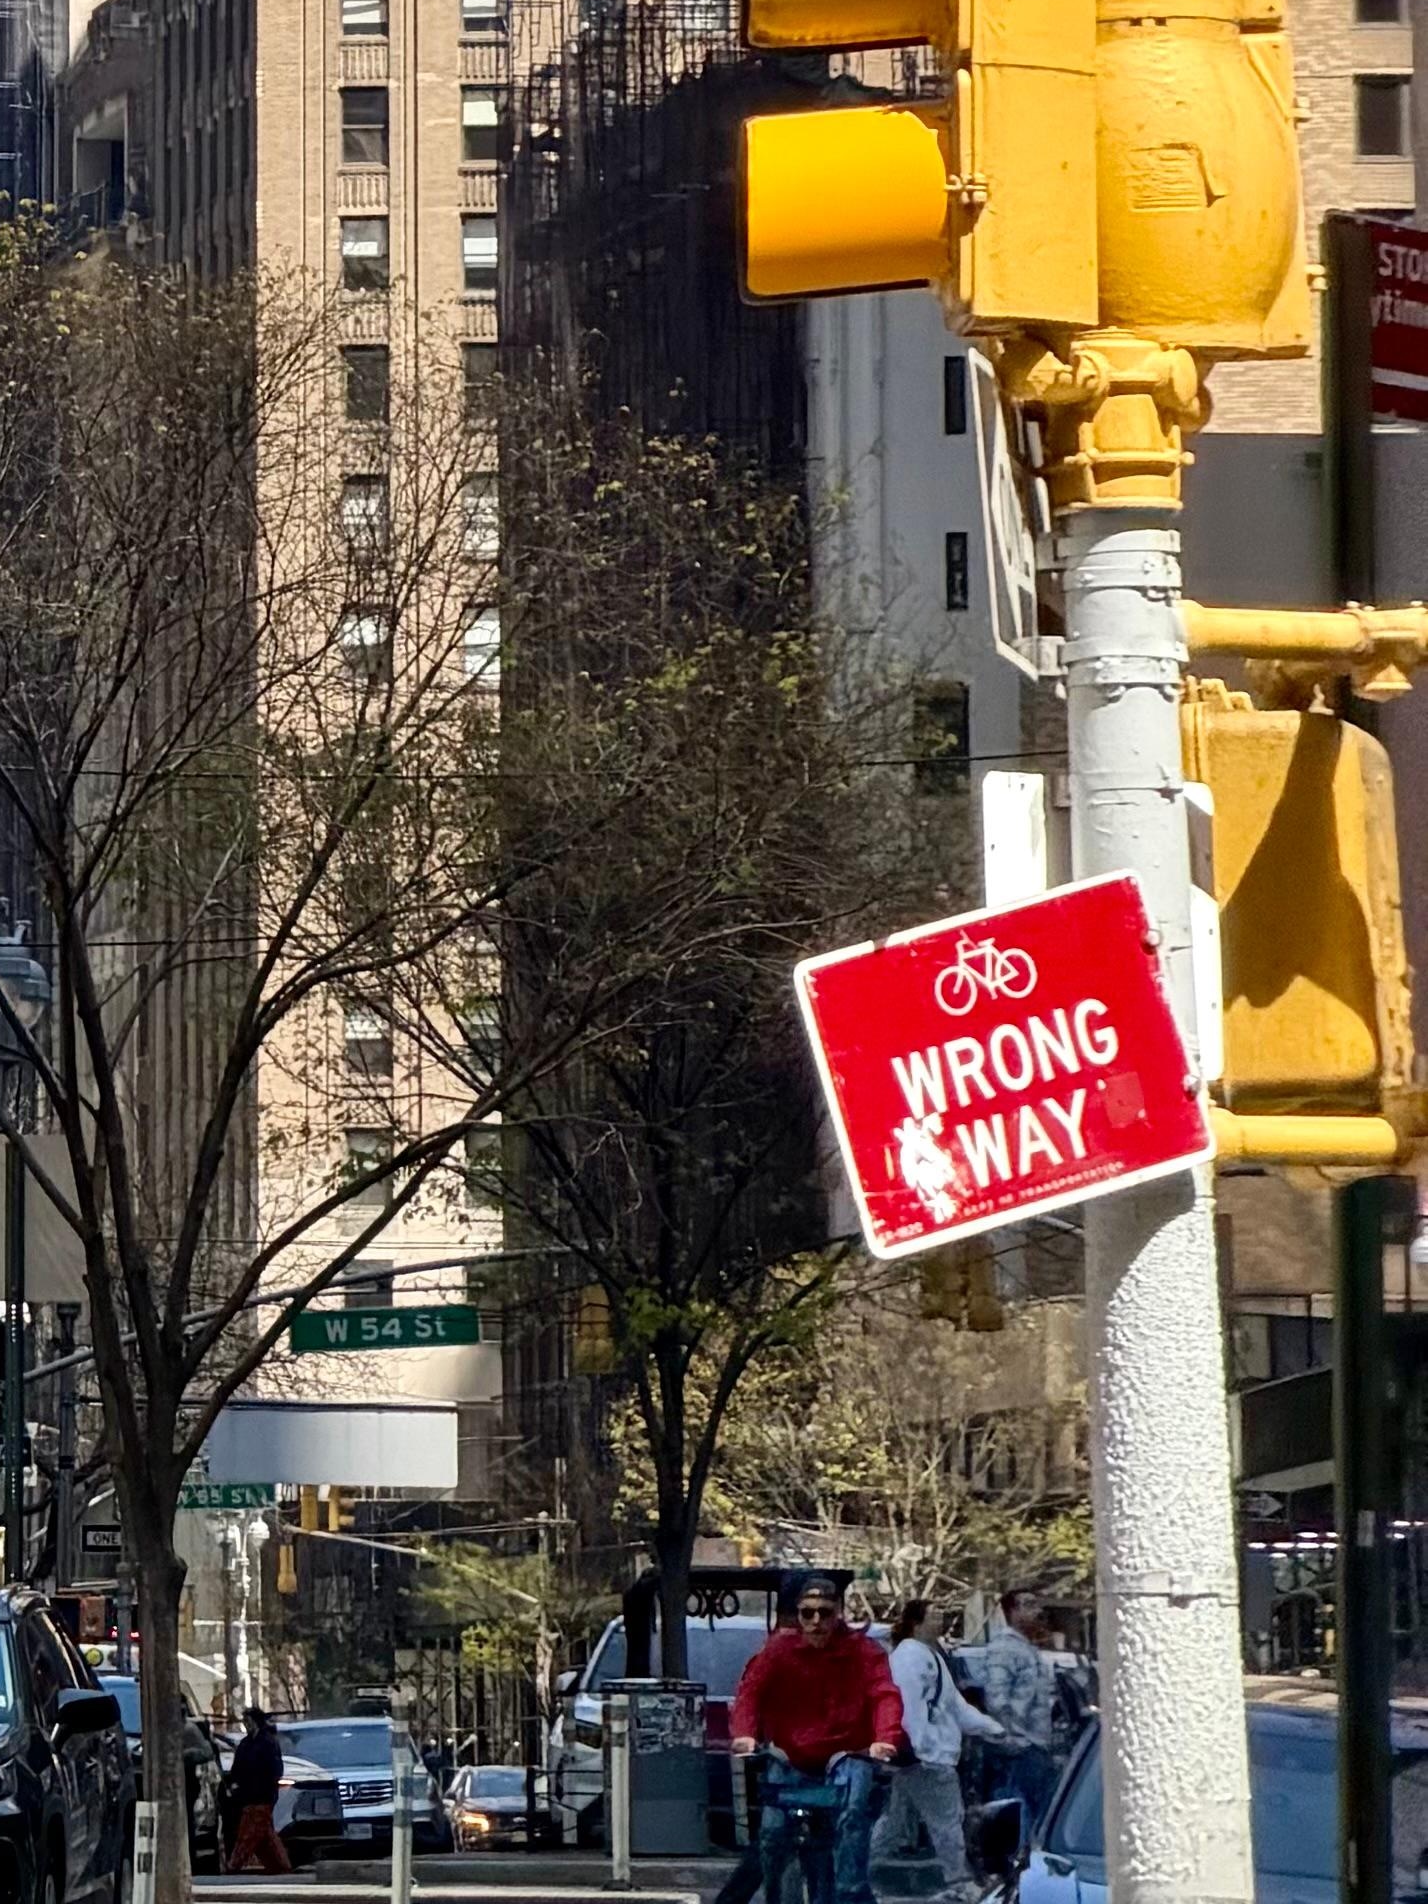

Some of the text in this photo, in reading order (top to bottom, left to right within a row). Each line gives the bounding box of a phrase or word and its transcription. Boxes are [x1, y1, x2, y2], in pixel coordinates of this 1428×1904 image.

[1377, 242, 1428, 283] STO
[891, 998, 1119, 1119] WRONG
[956, 1088, 1088, 1189] WAY
[325, 1315, 446, 1342] W 54 St
[94, 1534, 117, 1544] ONE
